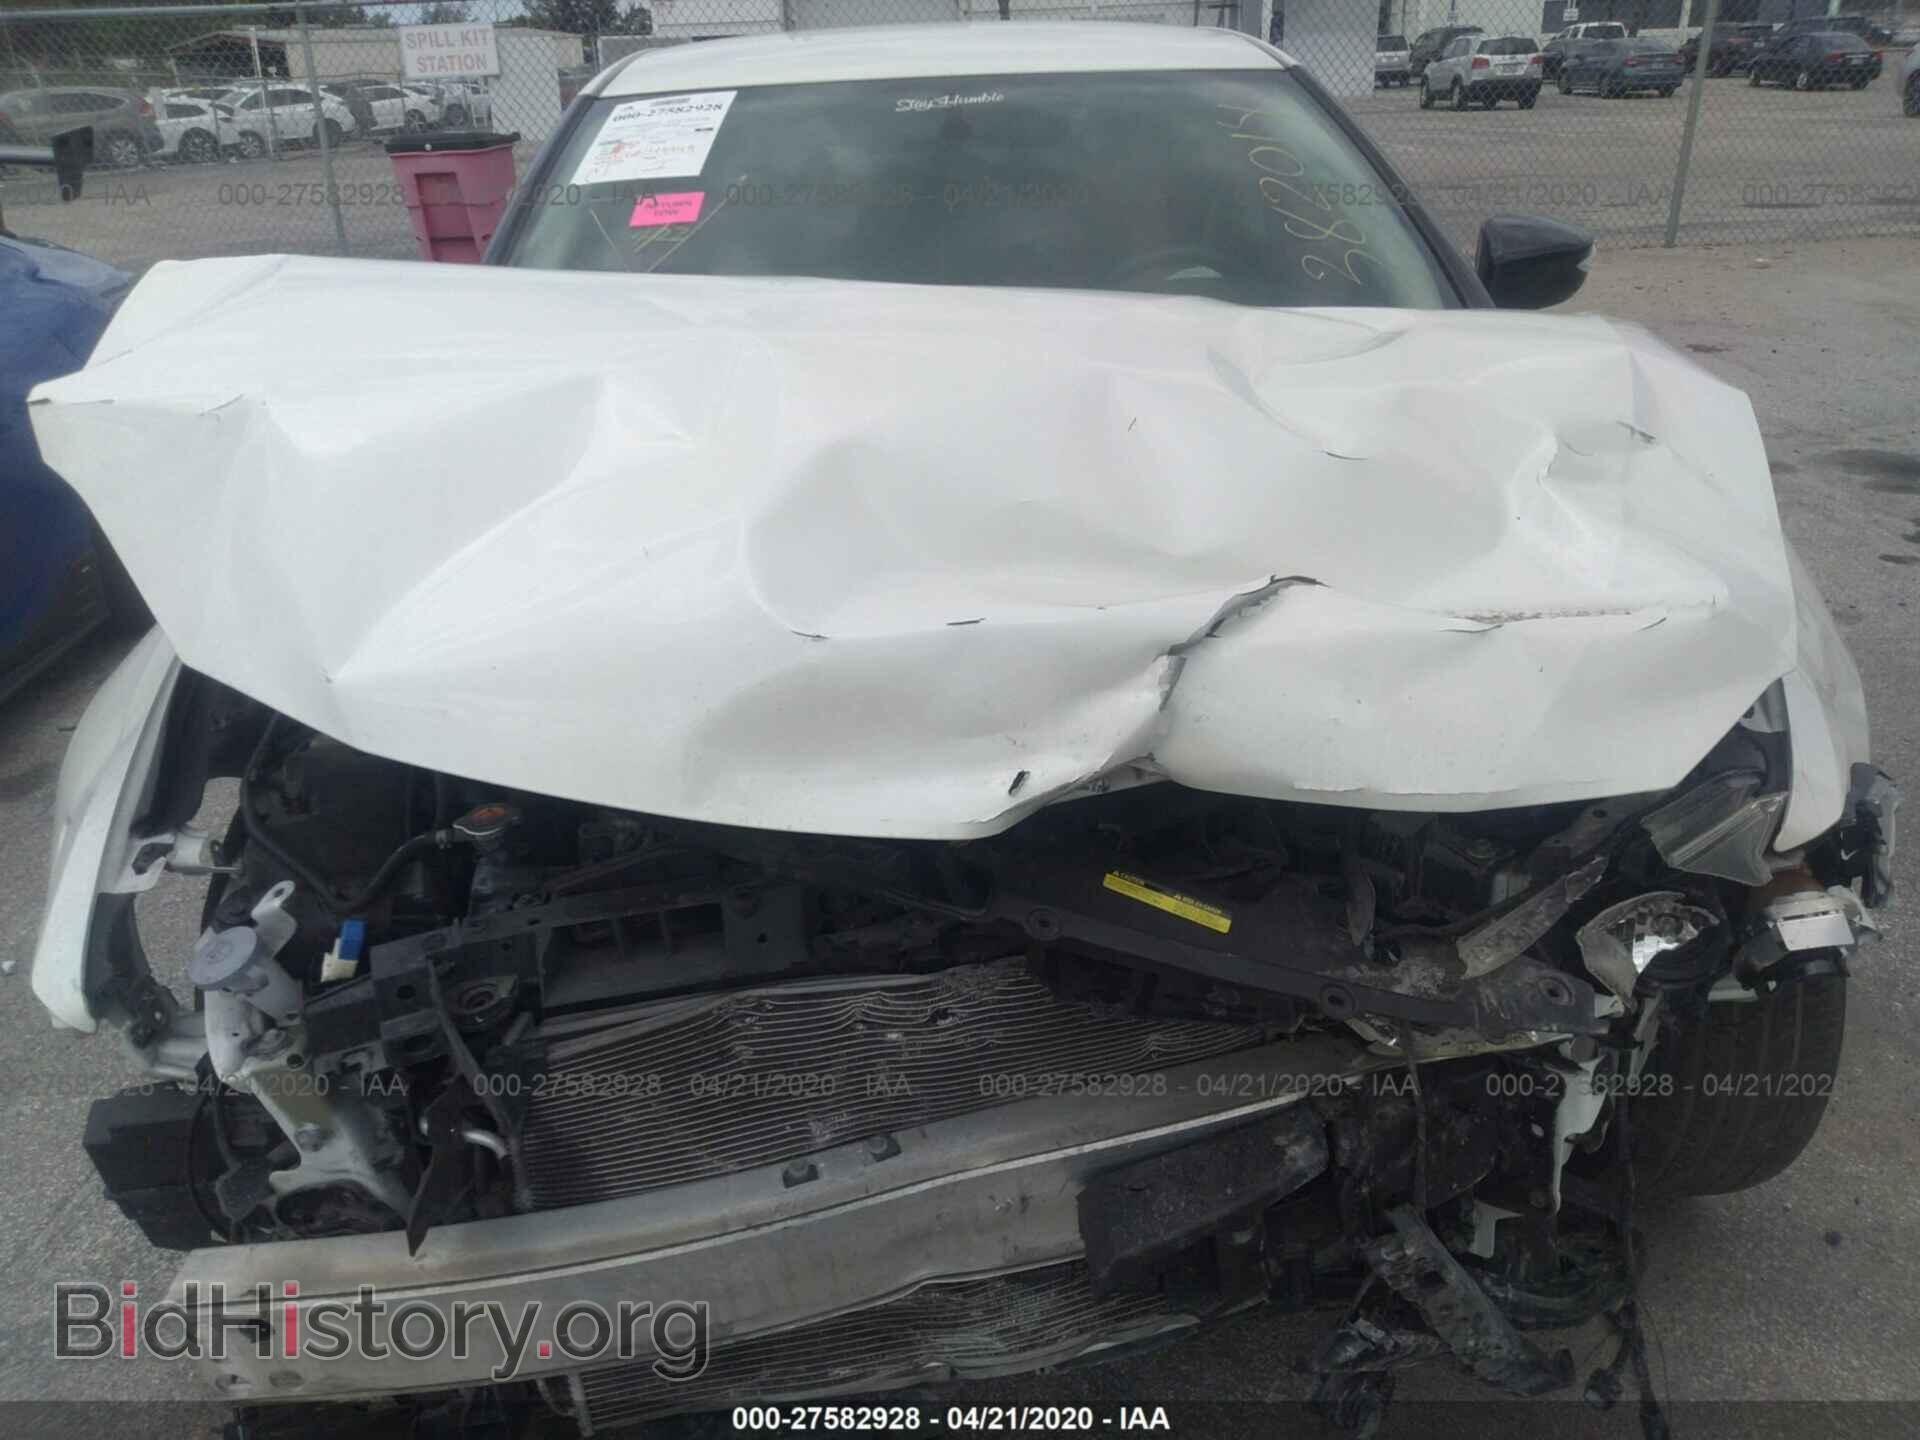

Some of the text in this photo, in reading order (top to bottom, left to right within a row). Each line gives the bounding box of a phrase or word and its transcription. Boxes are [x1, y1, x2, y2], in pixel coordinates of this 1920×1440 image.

[405, 28, 491, 50] SPILL KIT
[415, 53, 489, 74] STATION
